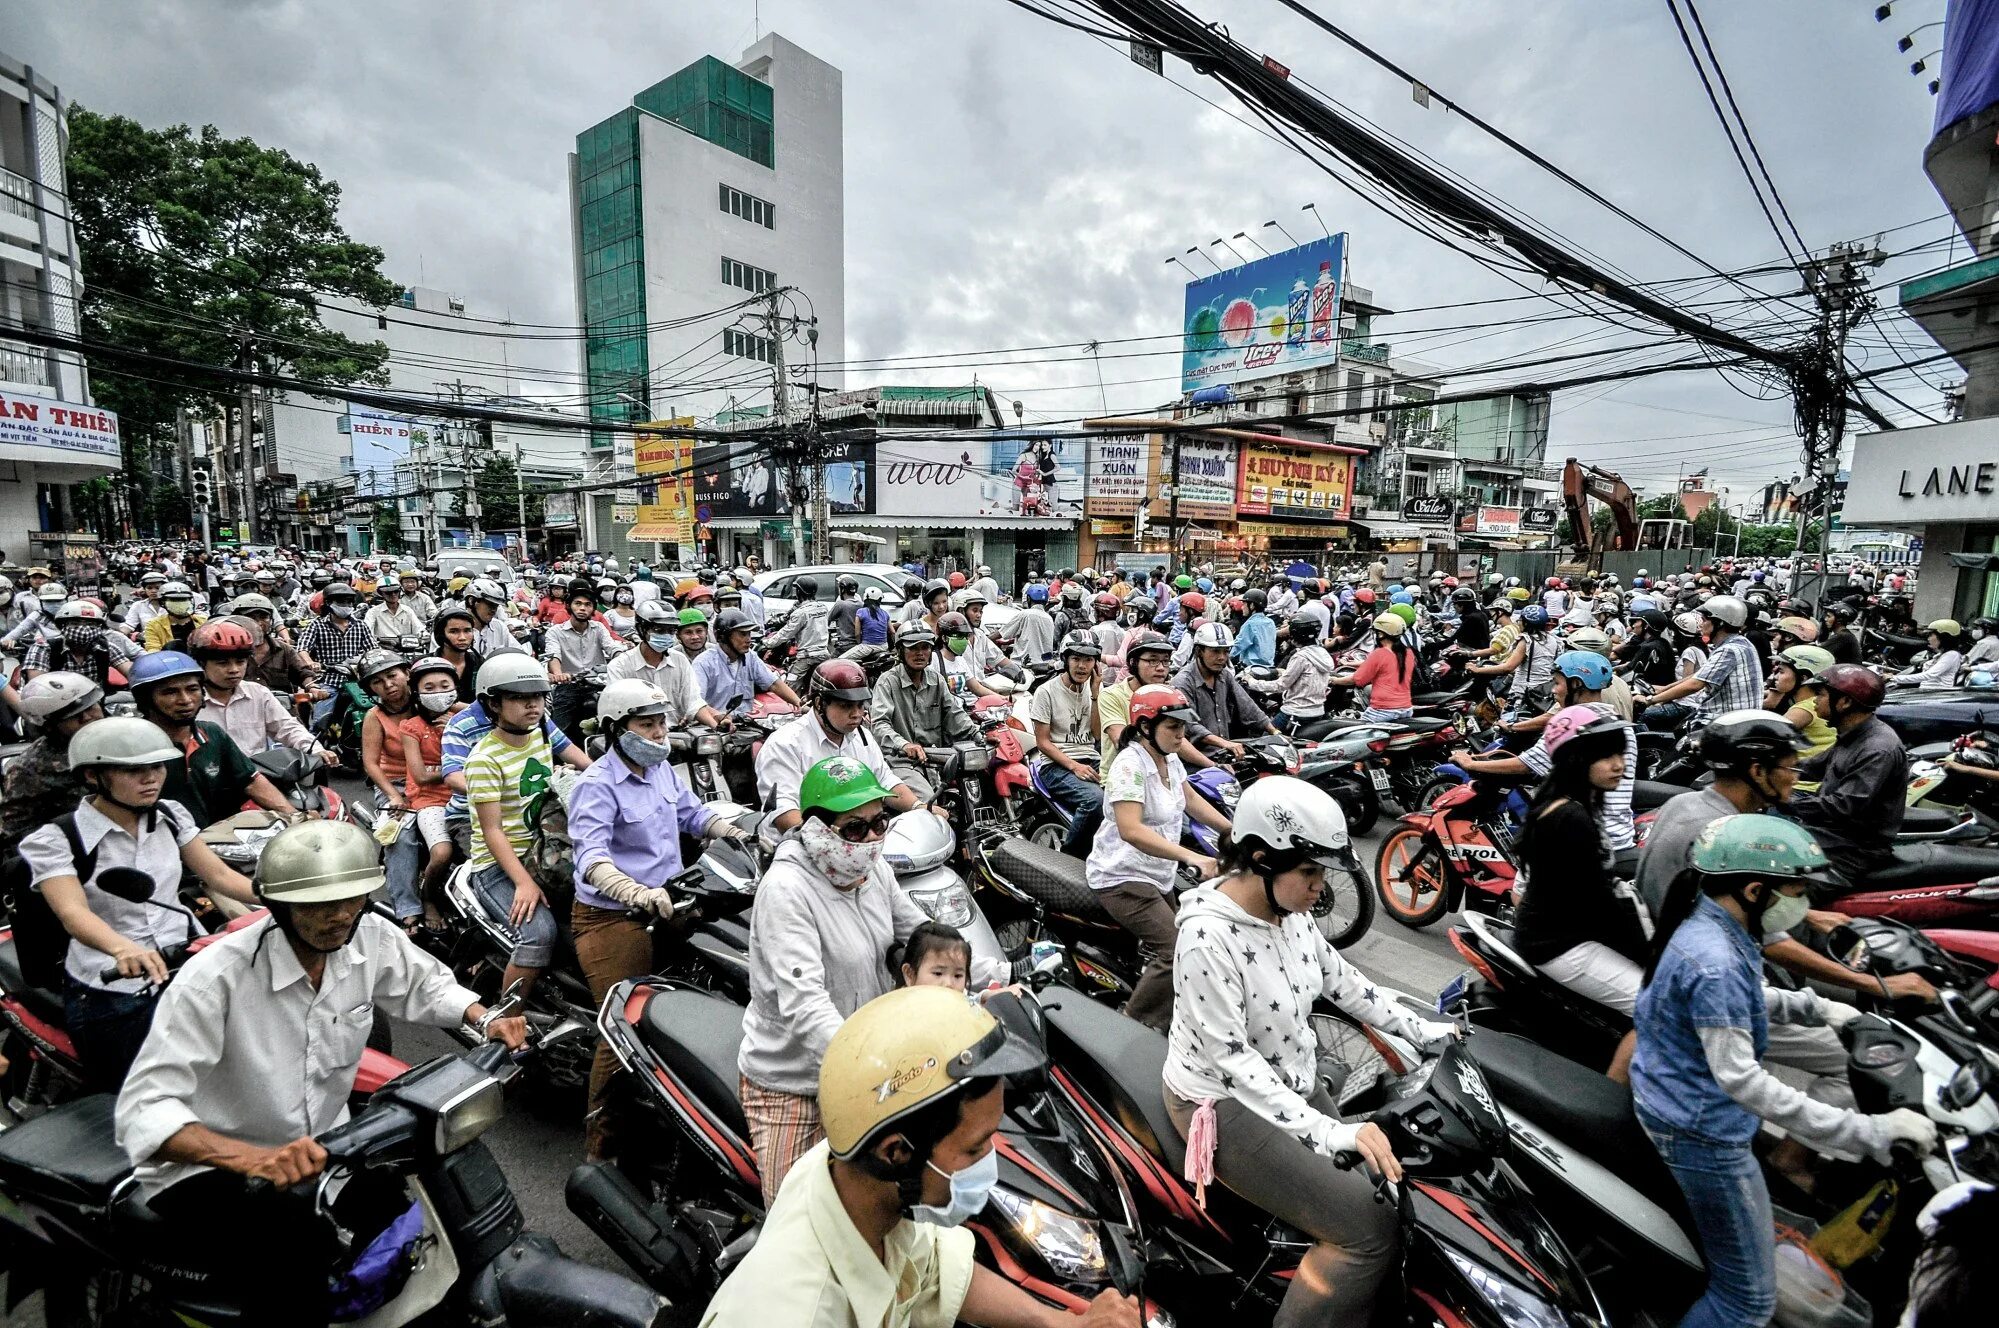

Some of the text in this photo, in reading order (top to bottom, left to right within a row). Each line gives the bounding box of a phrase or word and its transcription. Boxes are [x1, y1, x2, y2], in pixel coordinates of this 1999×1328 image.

[1101, 447, 1140, 458] THANH
[887, 461, 965, 486] wow
[1103, 460, 1136, 473] XUÂN
[1899, 462, 1998, 498] LANE
